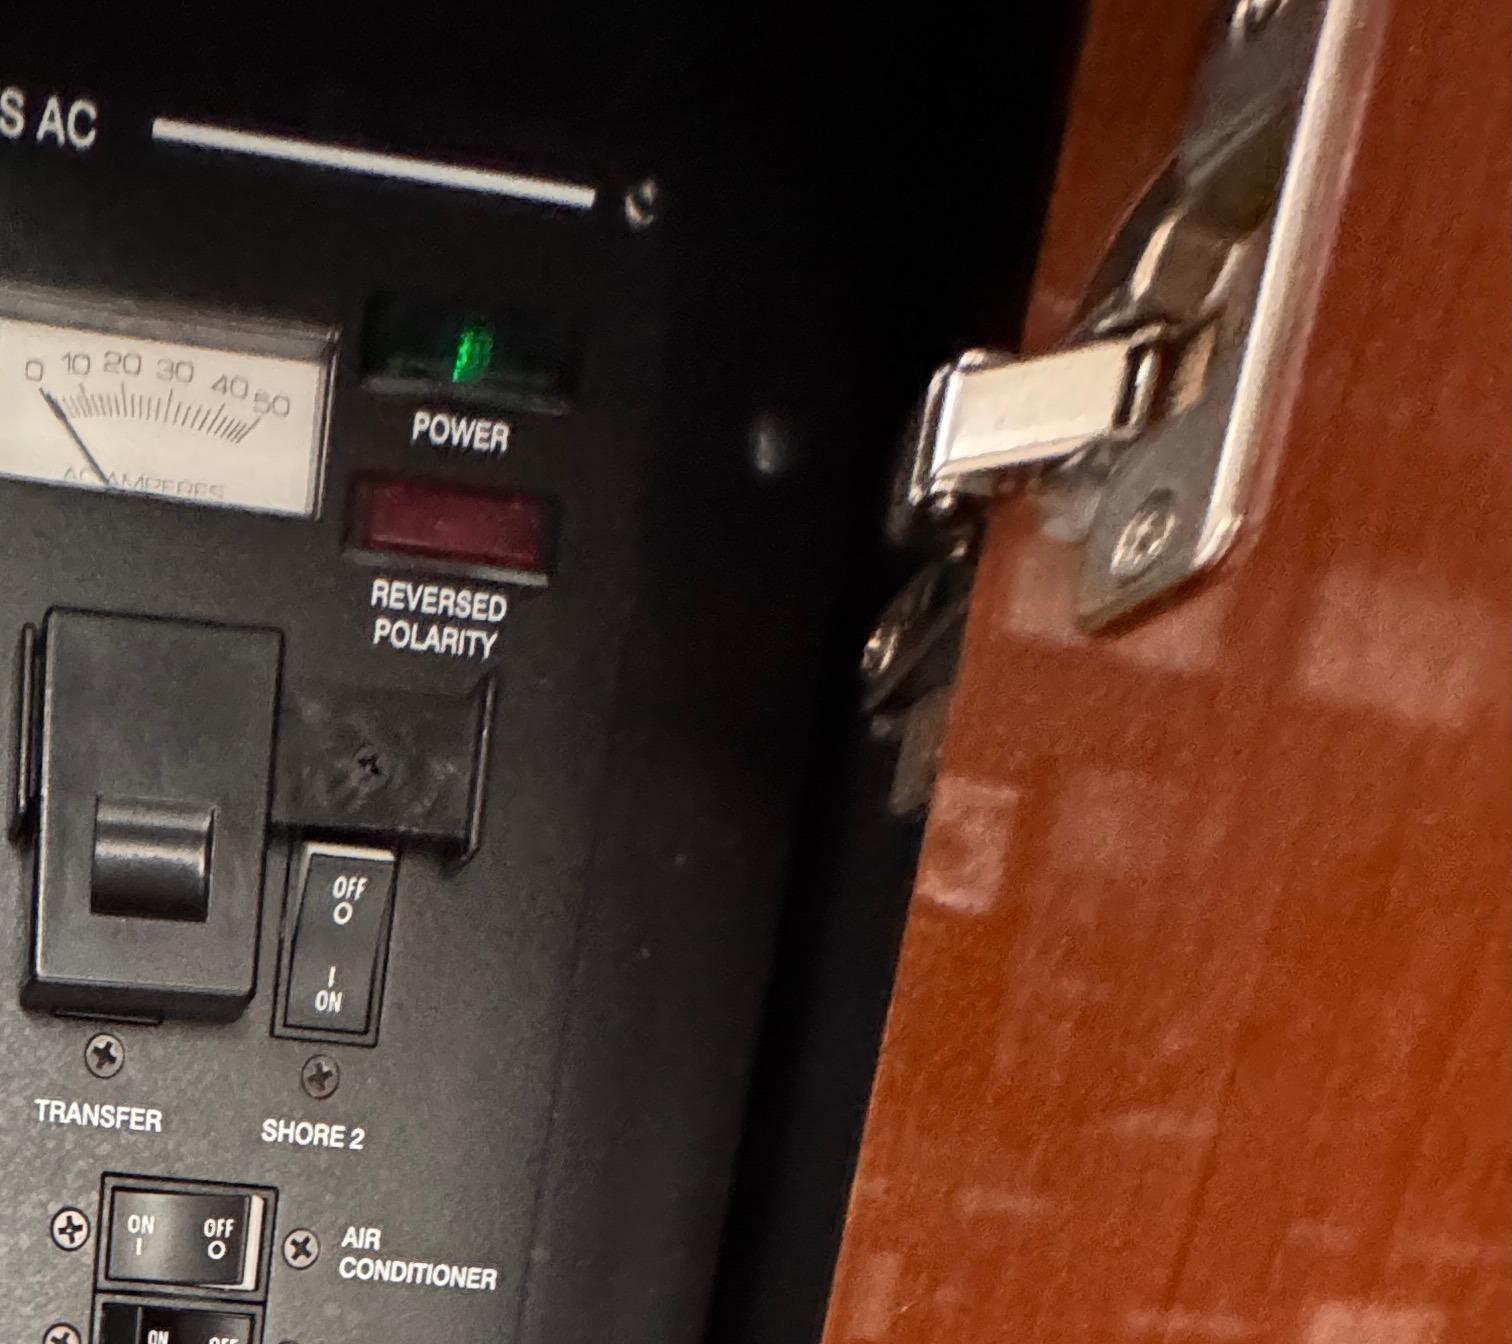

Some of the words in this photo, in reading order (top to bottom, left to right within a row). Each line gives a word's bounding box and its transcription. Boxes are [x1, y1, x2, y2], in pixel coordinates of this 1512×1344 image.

[37, 99, 98, 149] AC
[25, 359, 44, 382] 0
[61, 352, 91, 376] 10
[104, 351, 141, 376] 20
[156, 358, 194, 383] 30
[211, 375, 249, 400] 40
[253, 388, 290, 417] 50
[412, 411, 510, 453] POWER
[371, 579, 506, 622] REVERSED
[374, 618, 498, 659] POLARITY
[333, 875, 366, 901] OFF
[315, 989, 342, 1013] ON
[35, 1098, 163, 1132] TRANSFER
[261, 1118, 343, 1147] SHORE
[347, 1127, 365, 1150] 2
[128, 1214, 154, 1234] ON
[204, 1218, 234, 1238] OFF
[342, 1227, 382, 1251] AIR
[339, 1257, 498, 1291] CONDITIONER
